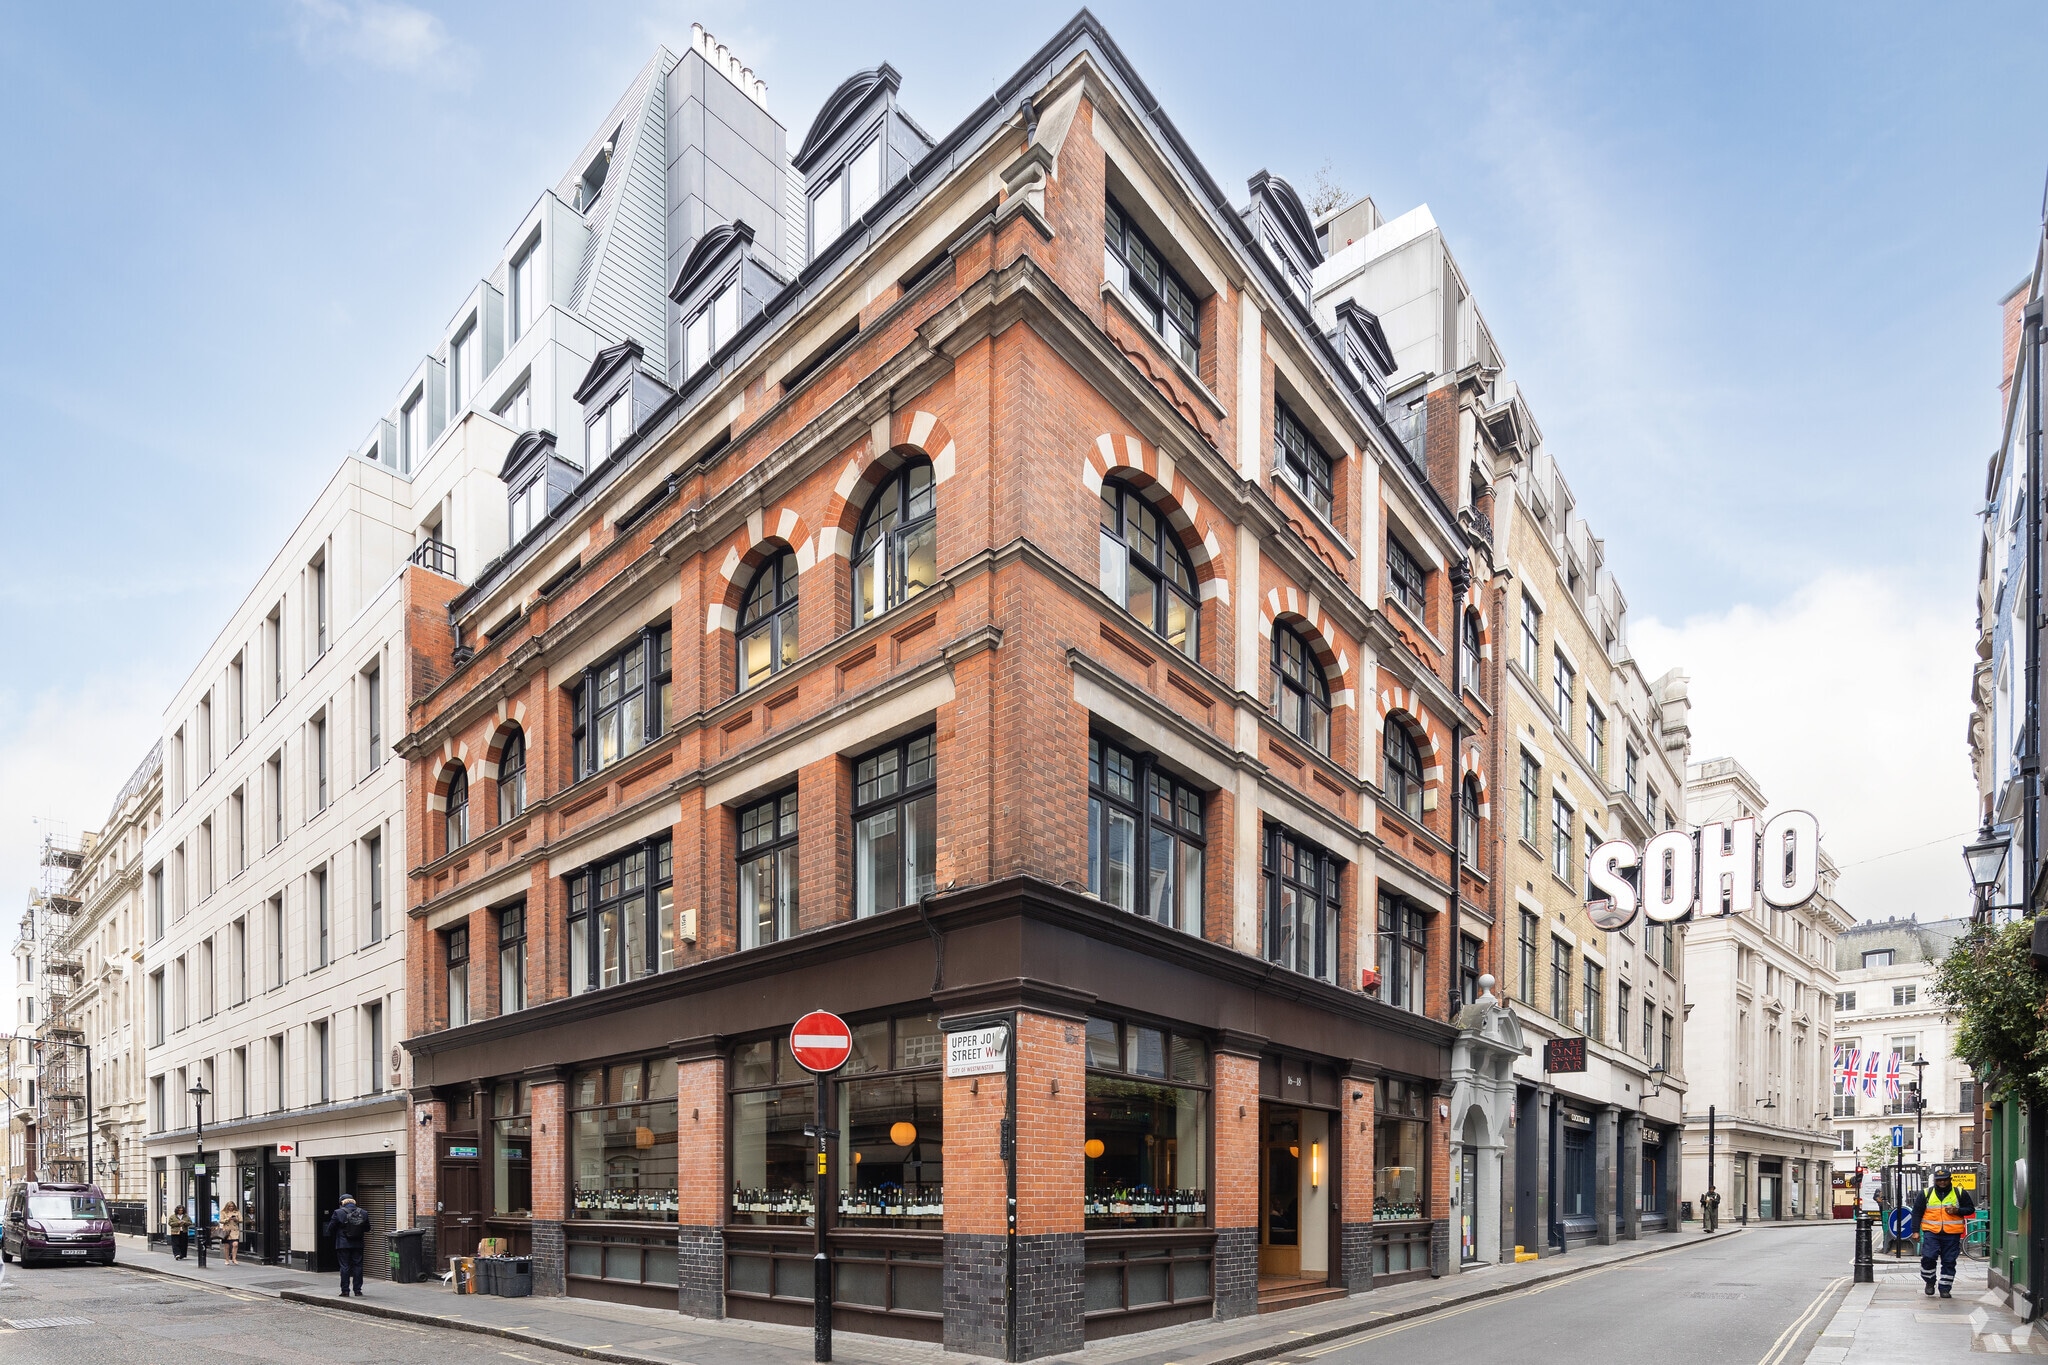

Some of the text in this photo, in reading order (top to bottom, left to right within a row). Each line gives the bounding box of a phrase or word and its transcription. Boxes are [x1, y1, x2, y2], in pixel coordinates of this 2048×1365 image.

[1586, 809, 1819, 932] SOHO
[952, 1032, 994, 1048] UPPER JO
[952, 1048, 981, 1062] STREET
[1551, 1047, 1582, 1057] ONE
[967, 1064, 994, 1072] WESTMINSTER
[1551, 1061, 1582, 1072] BAR
